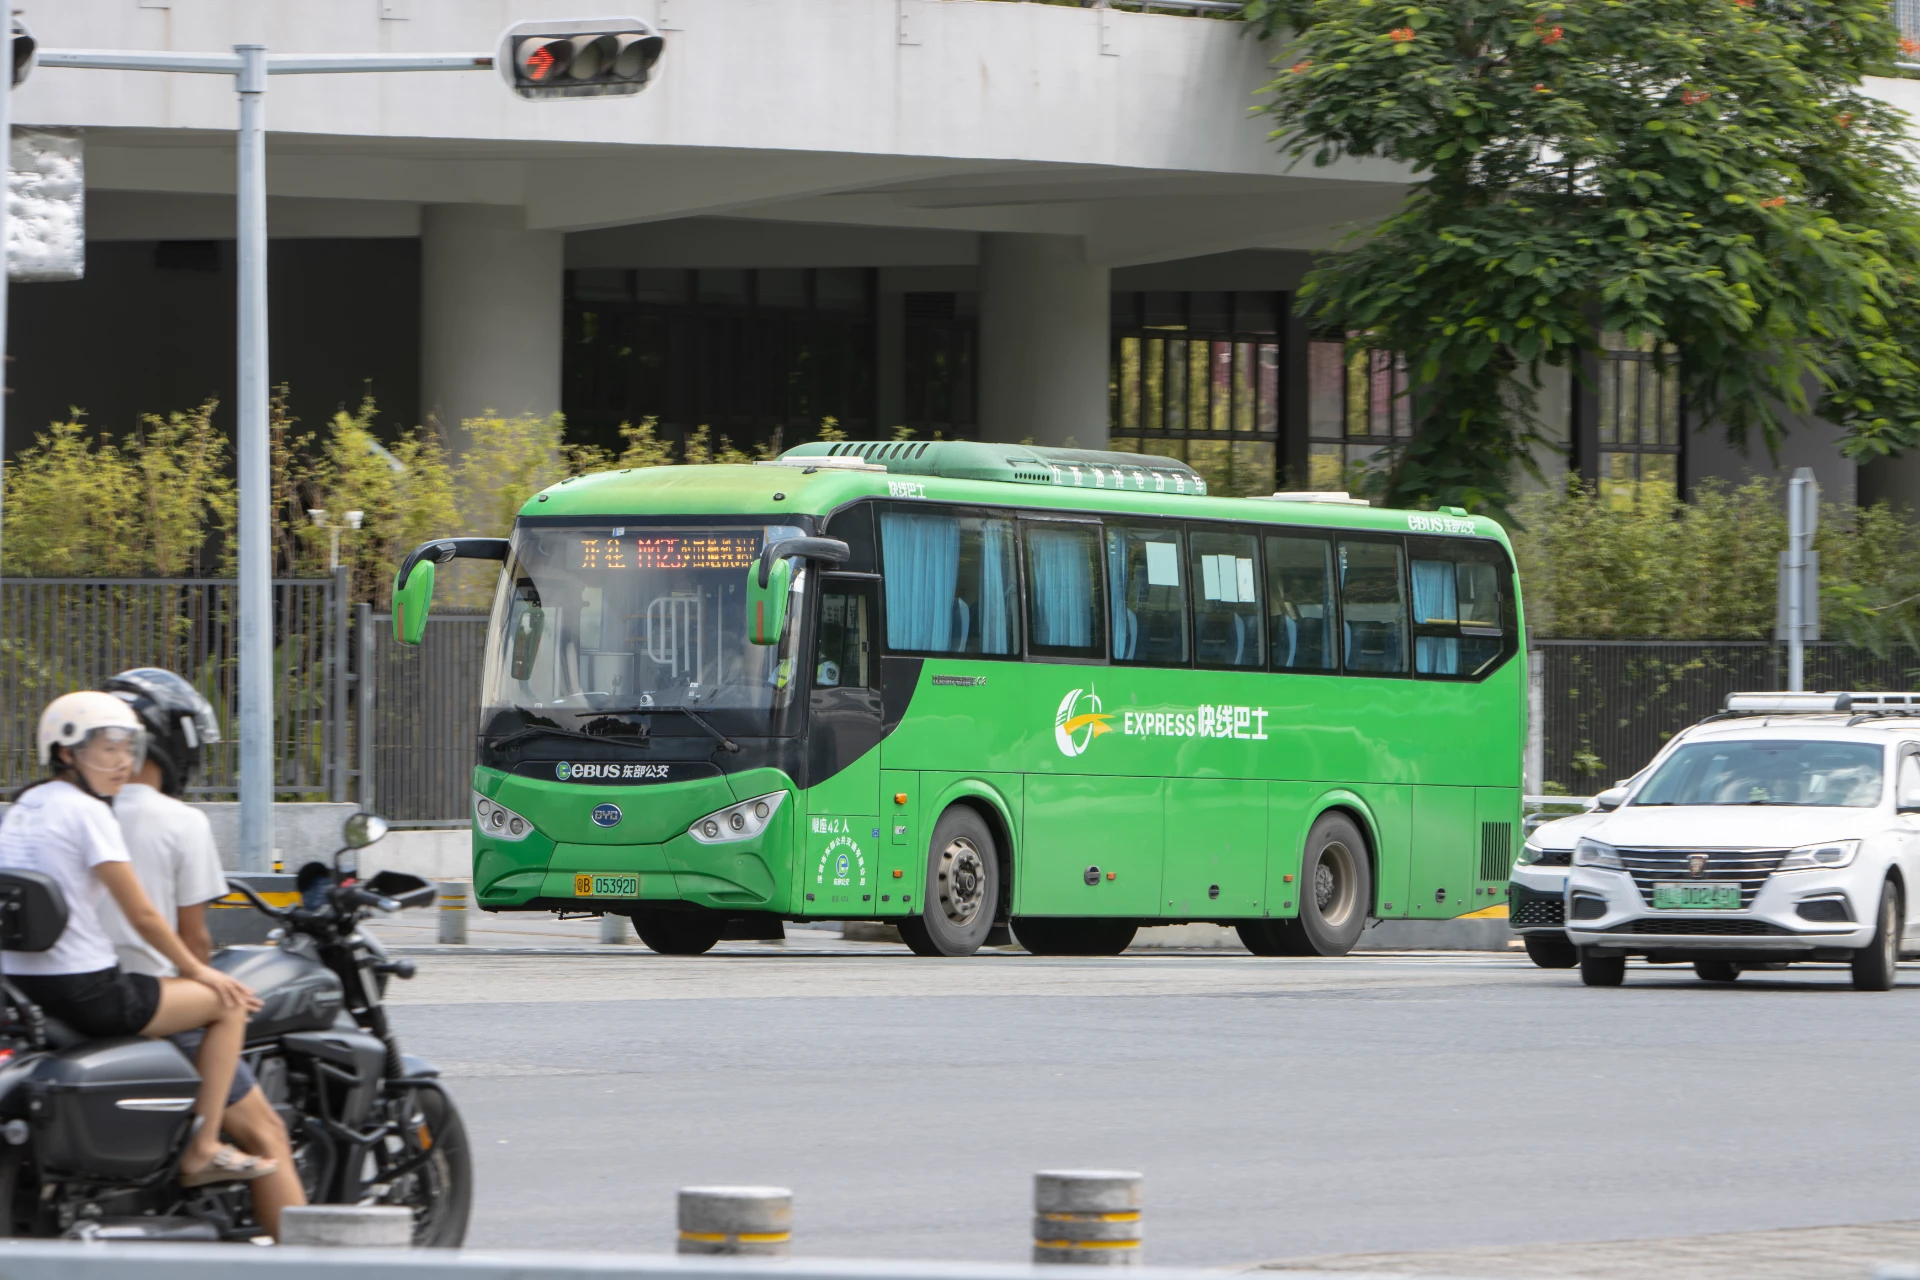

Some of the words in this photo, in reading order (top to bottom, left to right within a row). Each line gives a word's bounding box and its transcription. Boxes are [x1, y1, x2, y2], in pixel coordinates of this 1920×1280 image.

[888, 480, 927, 499] 快线巴士
[1408, 514, 1443, 532] eBUS
[1124, 712, 1196, 737] EXPRESS
[1198, 704, 1269, 740] 快线巴士
[622, 764, 669, 778] 东部公交
[594, 810, 618, 820] BYD
